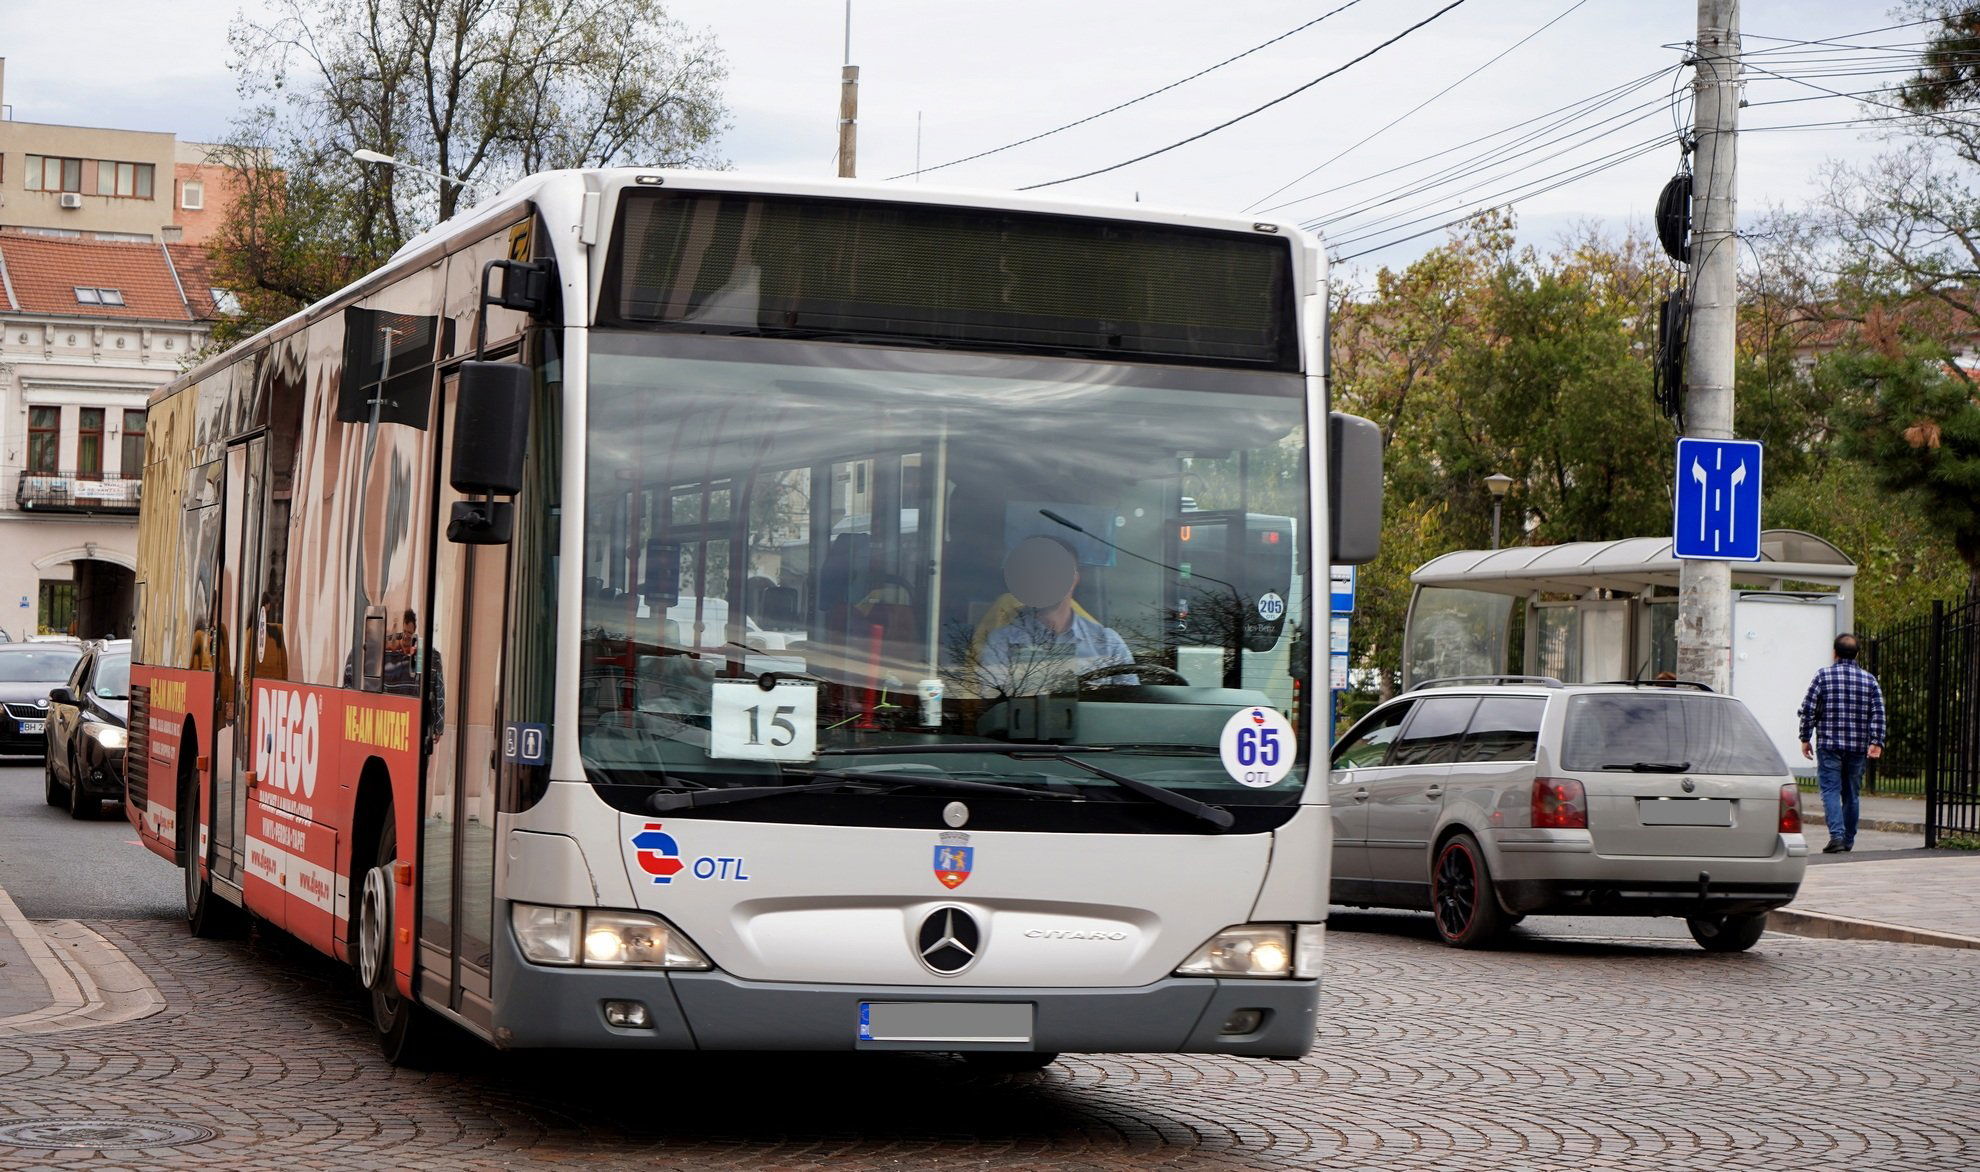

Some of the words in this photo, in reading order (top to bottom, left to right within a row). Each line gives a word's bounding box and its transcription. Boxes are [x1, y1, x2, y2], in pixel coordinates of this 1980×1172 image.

[1260, 600, 1281, 613] 205
[24, 722, 36, 732] BH
[345, 705, 373, 744] NE-AM
[374, 709, 410, 752] MUTAT!
[743, 705, 796, 746] 15
[256, 688, 319, 798] DIEGO
[1237, 727, 1279, 766] 65
[1244, 771, 1271, 783] OTL
[693, 857, 749, 880] OTL
[1023, 928, 1128, 941] CITARO
